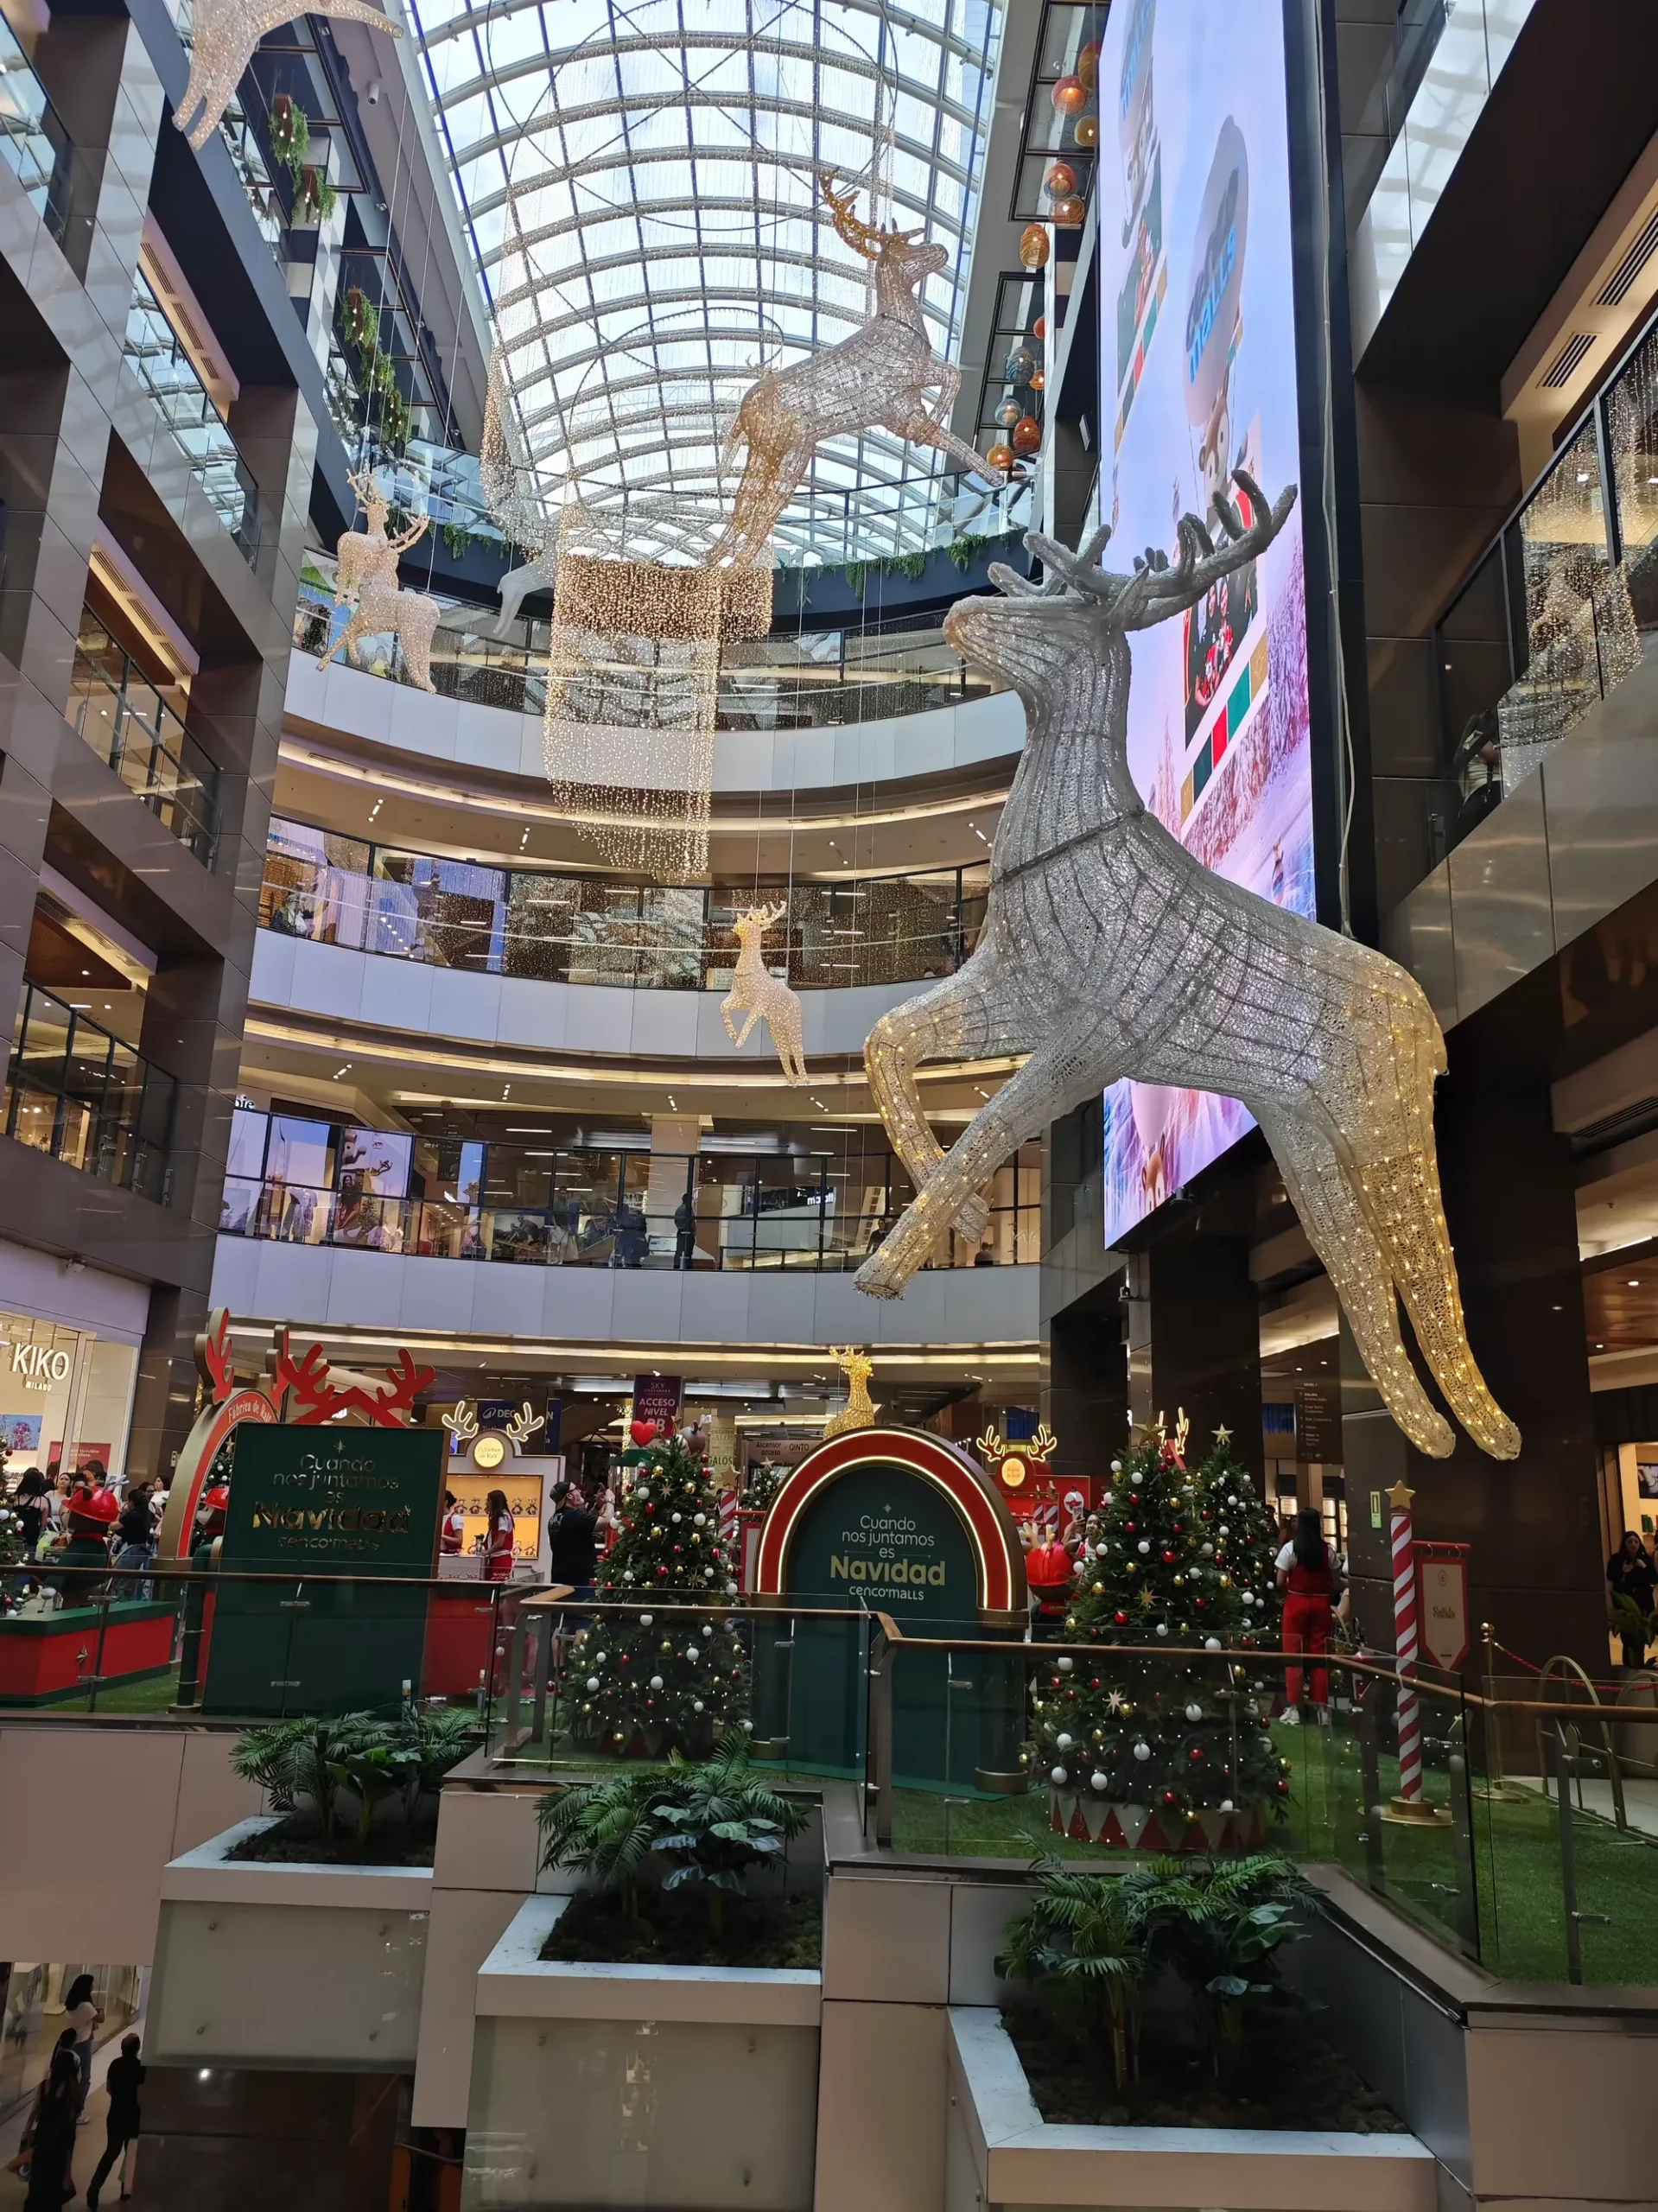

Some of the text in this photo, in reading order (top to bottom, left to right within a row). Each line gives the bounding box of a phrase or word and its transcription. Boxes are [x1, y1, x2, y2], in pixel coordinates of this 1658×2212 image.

[12, 1343, 70, 1381] KIKO
[25, 1381, 52, 1392] MILANO
[252, 1400, 259, 1414] de
[638, 1397, 676, 1407] ACCESO
[644, 1408, 669, 1416] NIVEL
[301, 1454, 376, 1472] Cuando
[708, 1456, 733, 1465] GALOS
[324, 1491, 345, 1503] es
[252, 1501, 411, 1534] Navidad
[860, 1515, 917, 1531] Cuando
[842, 1529, 935, 1547] nos juntamos
[879, 1547, 895, 1559] es
[830, 1554, 946, 1586] Navidad
[1432, 1605, 1456, 1619] Salida
